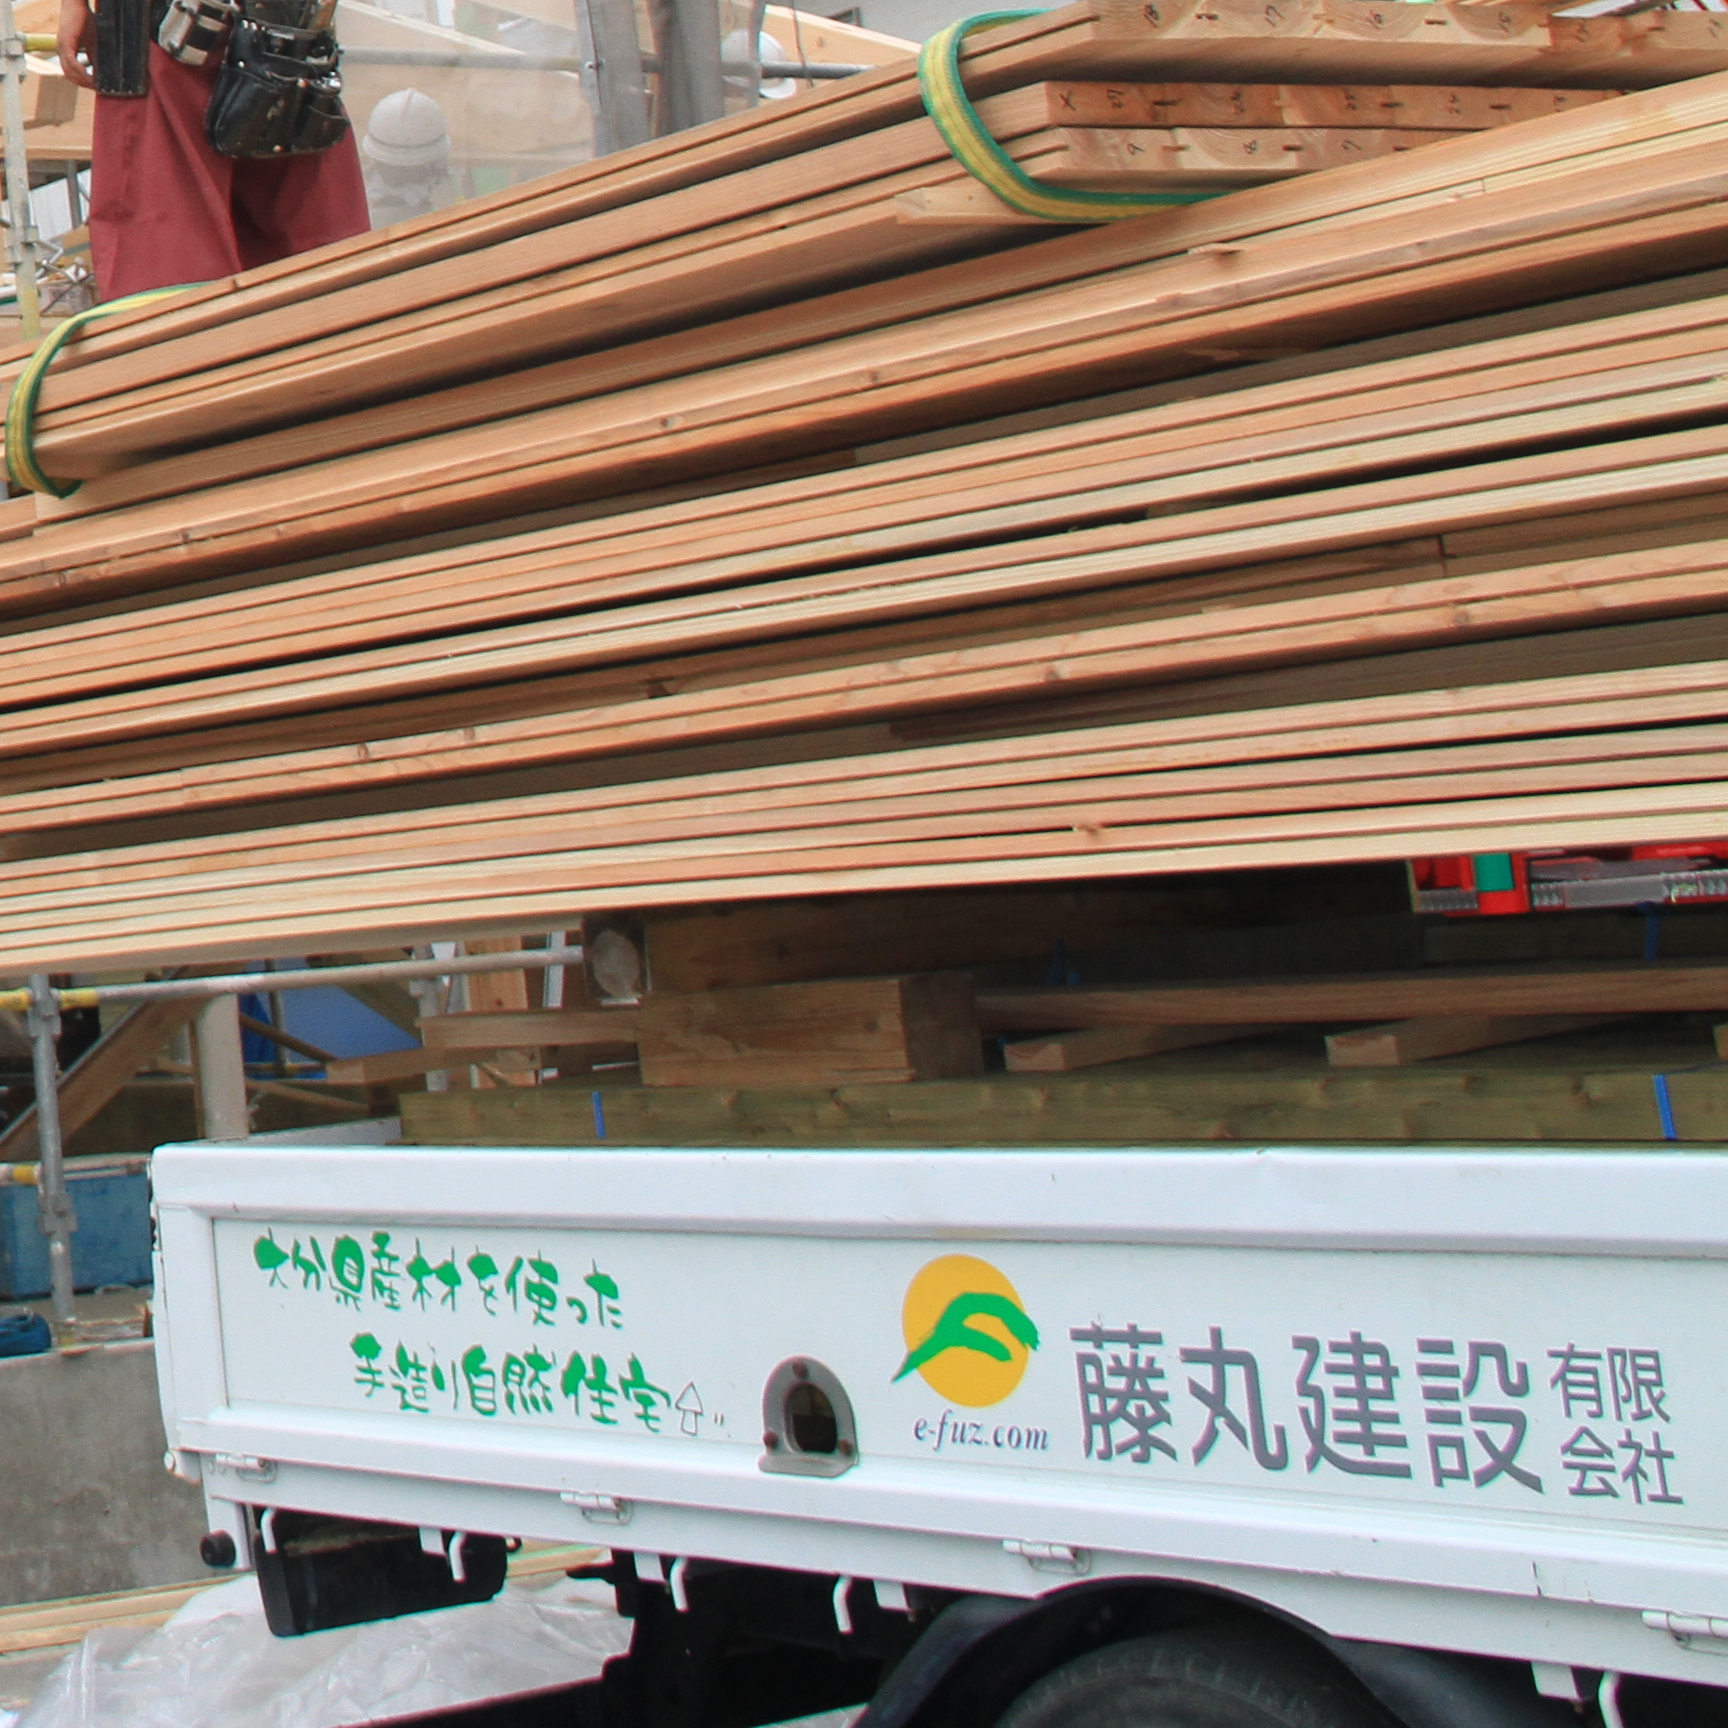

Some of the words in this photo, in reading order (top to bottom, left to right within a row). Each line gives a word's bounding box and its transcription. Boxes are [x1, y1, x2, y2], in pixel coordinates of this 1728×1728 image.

[253, 1227, 623, 1329] 大分県産材を使った
[350, 1331, 671, 1433] 手造り自然住宅
[1069, 1320, 1544, 1495] 藤丸建設
[1548, 1343, 1672, 1425] 有限
[914, 1408, 1048, 1452] e-fuz.com
[1559, 1427, 1684, 1505] 会社
